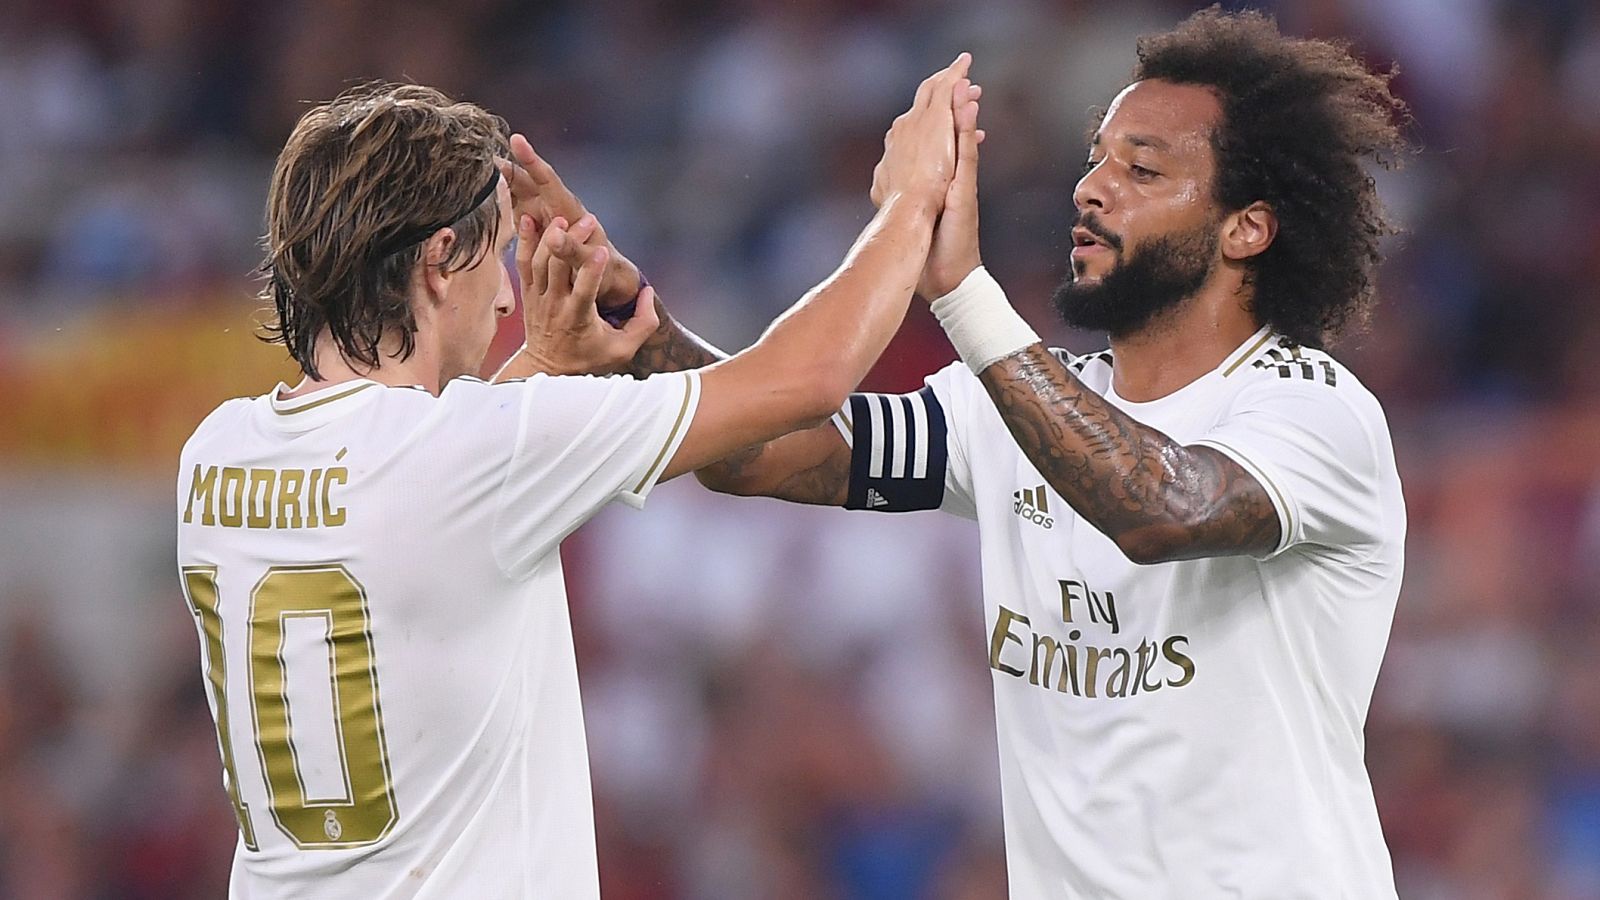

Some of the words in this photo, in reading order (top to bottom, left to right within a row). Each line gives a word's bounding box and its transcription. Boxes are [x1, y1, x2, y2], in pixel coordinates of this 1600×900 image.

[183, 446, 348, 529] MODRIĆ
[1058, 579, 1120, 634] Fly
[990, 605, 1196, 699] Emirates
[181, 563, 401, 852] 10
